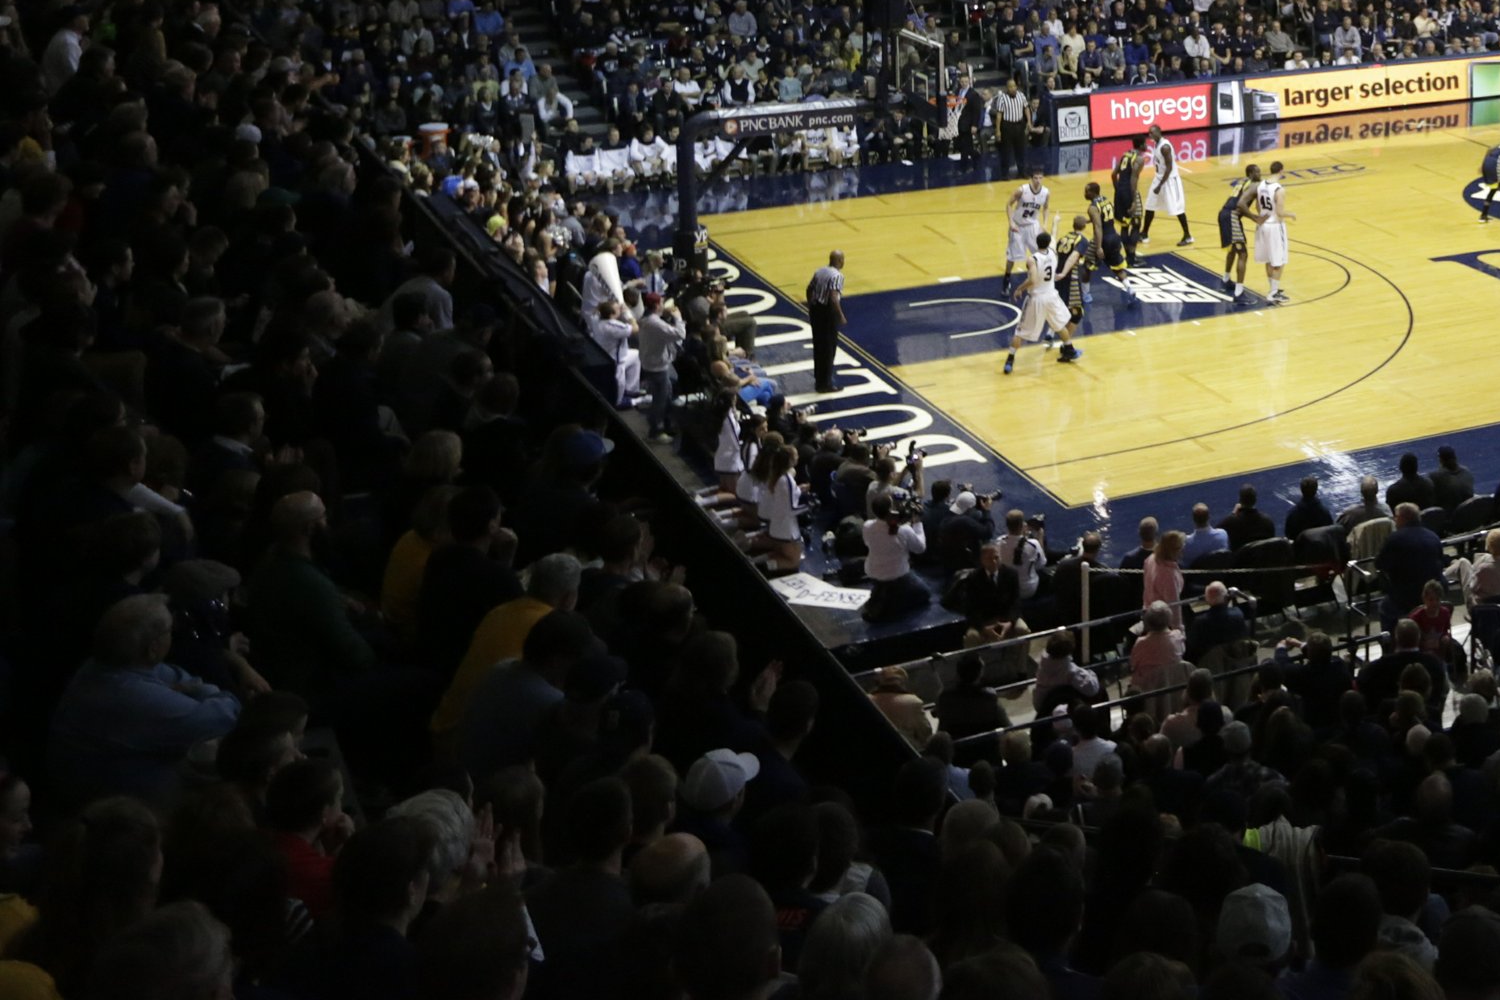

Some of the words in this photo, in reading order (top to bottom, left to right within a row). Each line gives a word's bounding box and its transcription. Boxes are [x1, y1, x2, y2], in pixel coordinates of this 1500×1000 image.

[1284, 84, 1353, 108] larger
[1359, 72, 1459, 98] selection
[1111, 95, 1207, 125] hhgregg
[740, 118, 769, 131] PNC
[769, 114, 803, 128] BANK
[808, 112, 853, 127] pnc.com
[1060, 124, 1089, 139] BUTLER
[1022, 210, 1035, 218] 24
[1044, 266, 1052, 282] 3
[797, 589, 866, 606] D-FENSE
